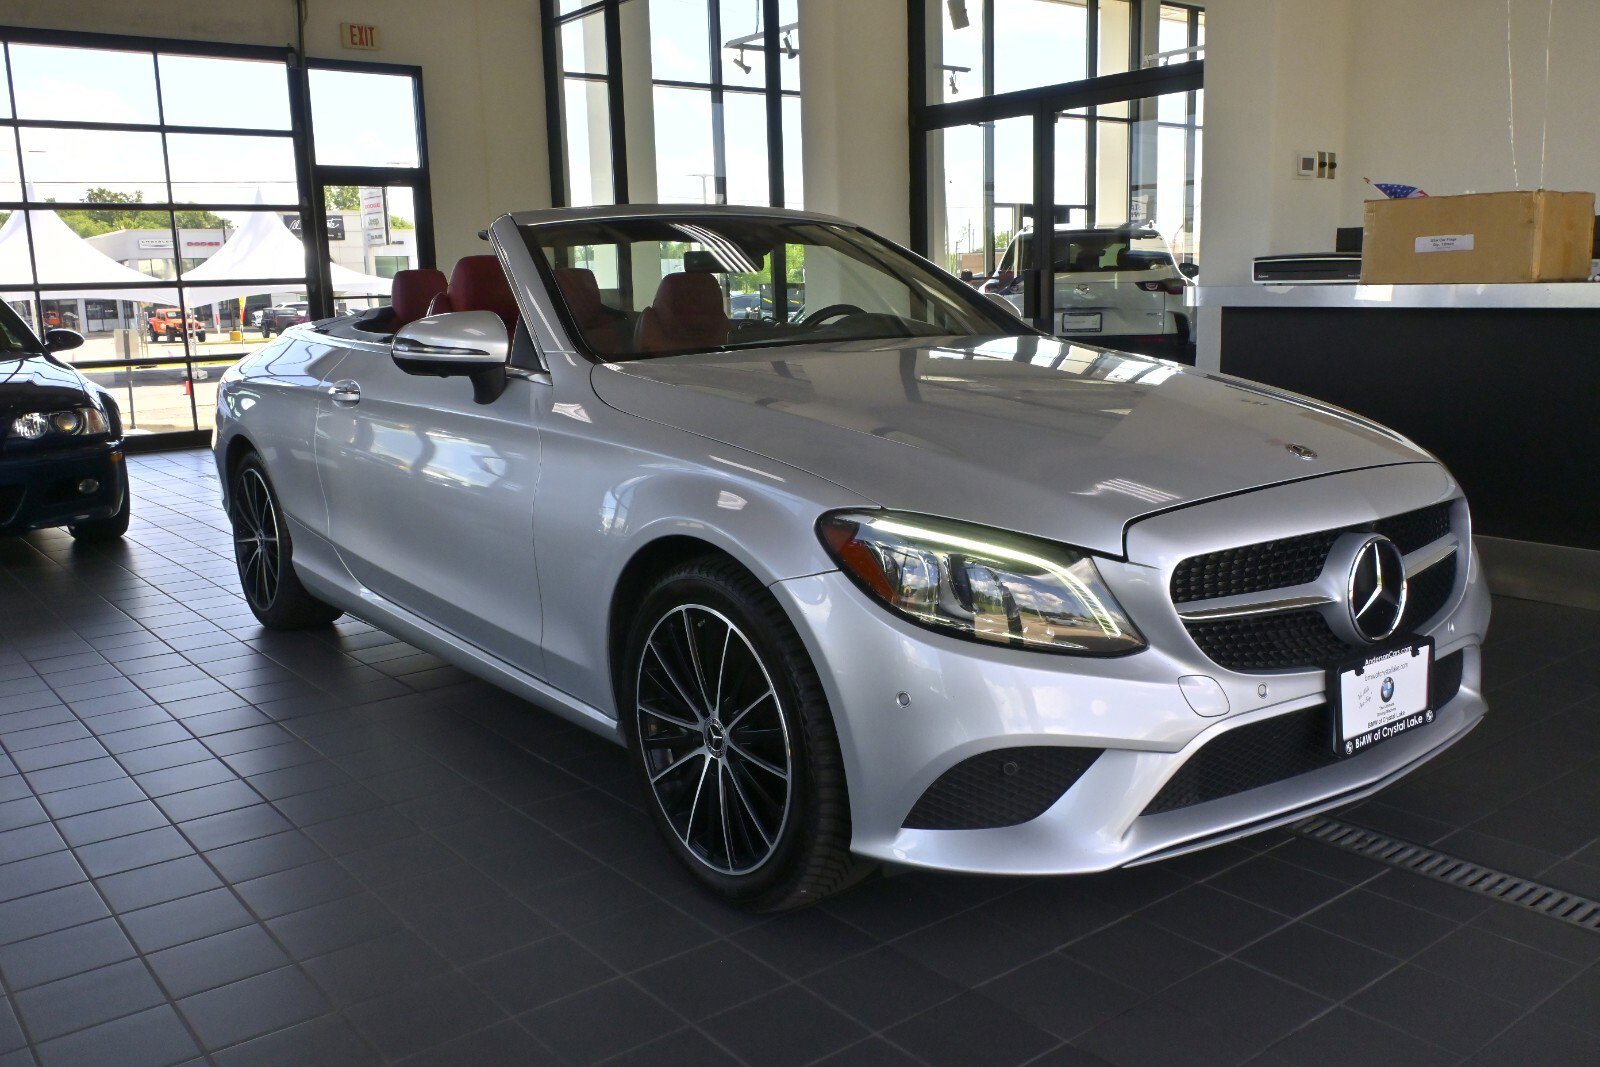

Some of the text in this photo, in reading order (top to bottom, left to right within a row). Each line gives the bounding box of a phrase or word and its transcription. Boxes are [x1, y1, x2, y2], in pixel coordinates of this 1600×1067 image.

[350, 24, 375, 47] EXIT
[1355, 715, 1423, 749] BMW of Crystal Lake
